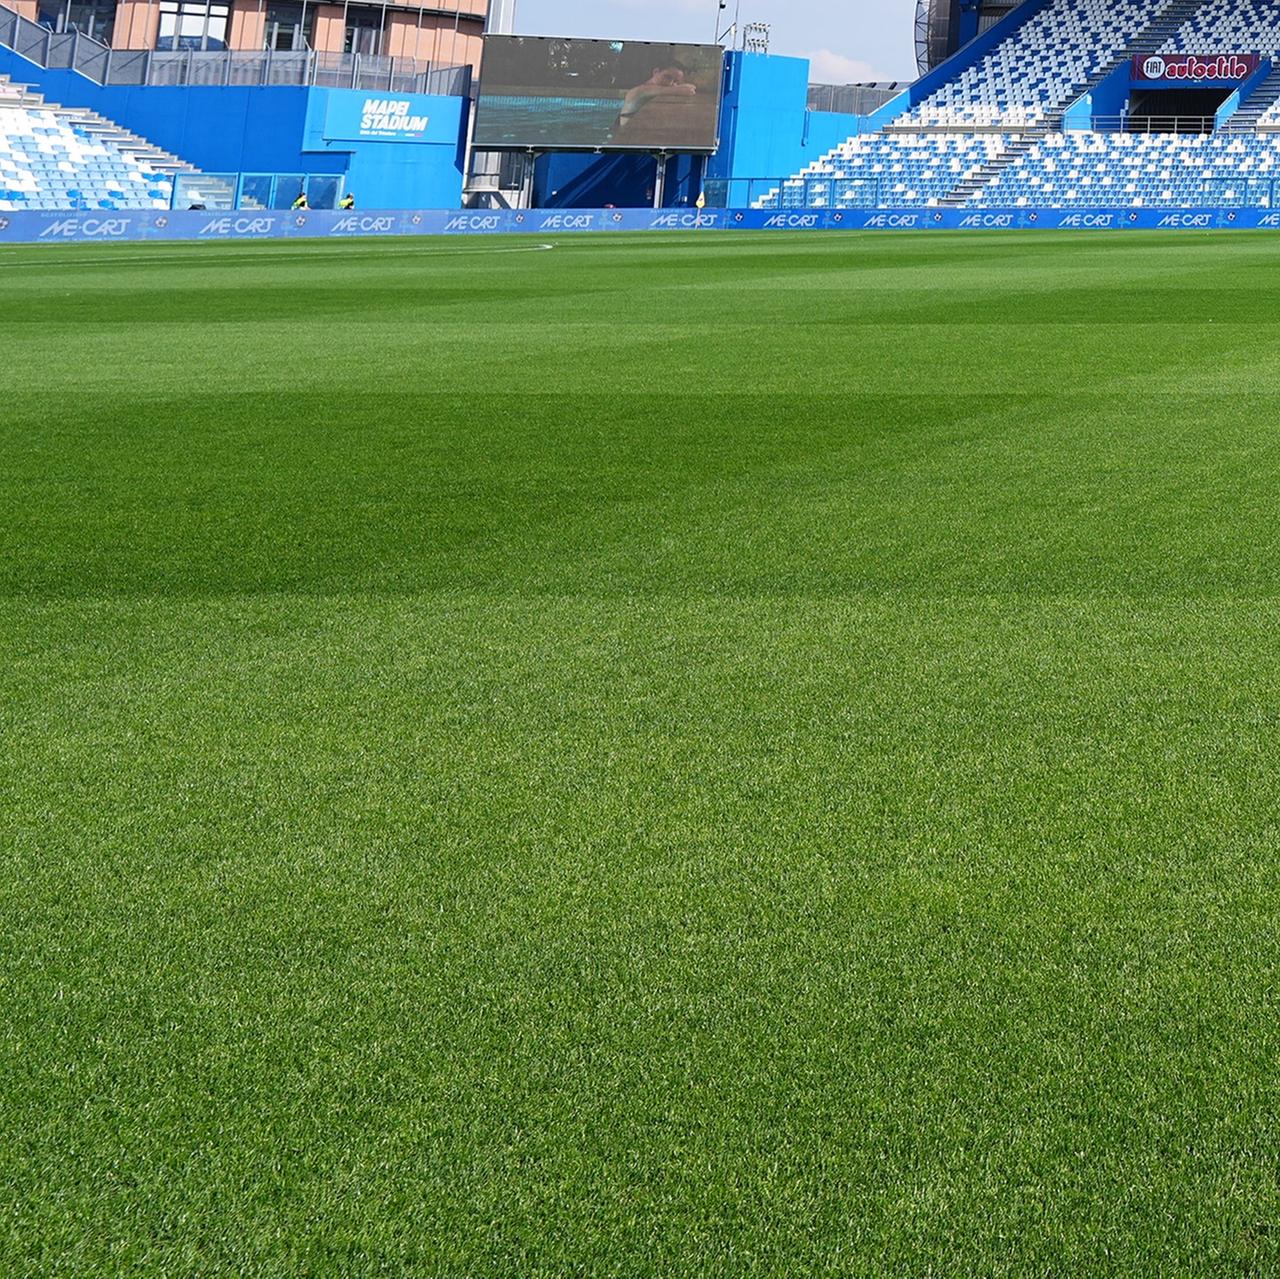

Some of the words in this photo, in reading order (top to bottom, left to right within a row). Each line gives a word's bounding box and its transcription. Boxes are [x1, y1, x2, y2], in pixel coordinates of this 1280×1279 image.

[1145, 61, 1162, 74] FIAT
[1165, 56, 1247, 79] autostile
[362, 99, 410, 115] MAPEI
[360, 114, 429, 132] STADIUM
